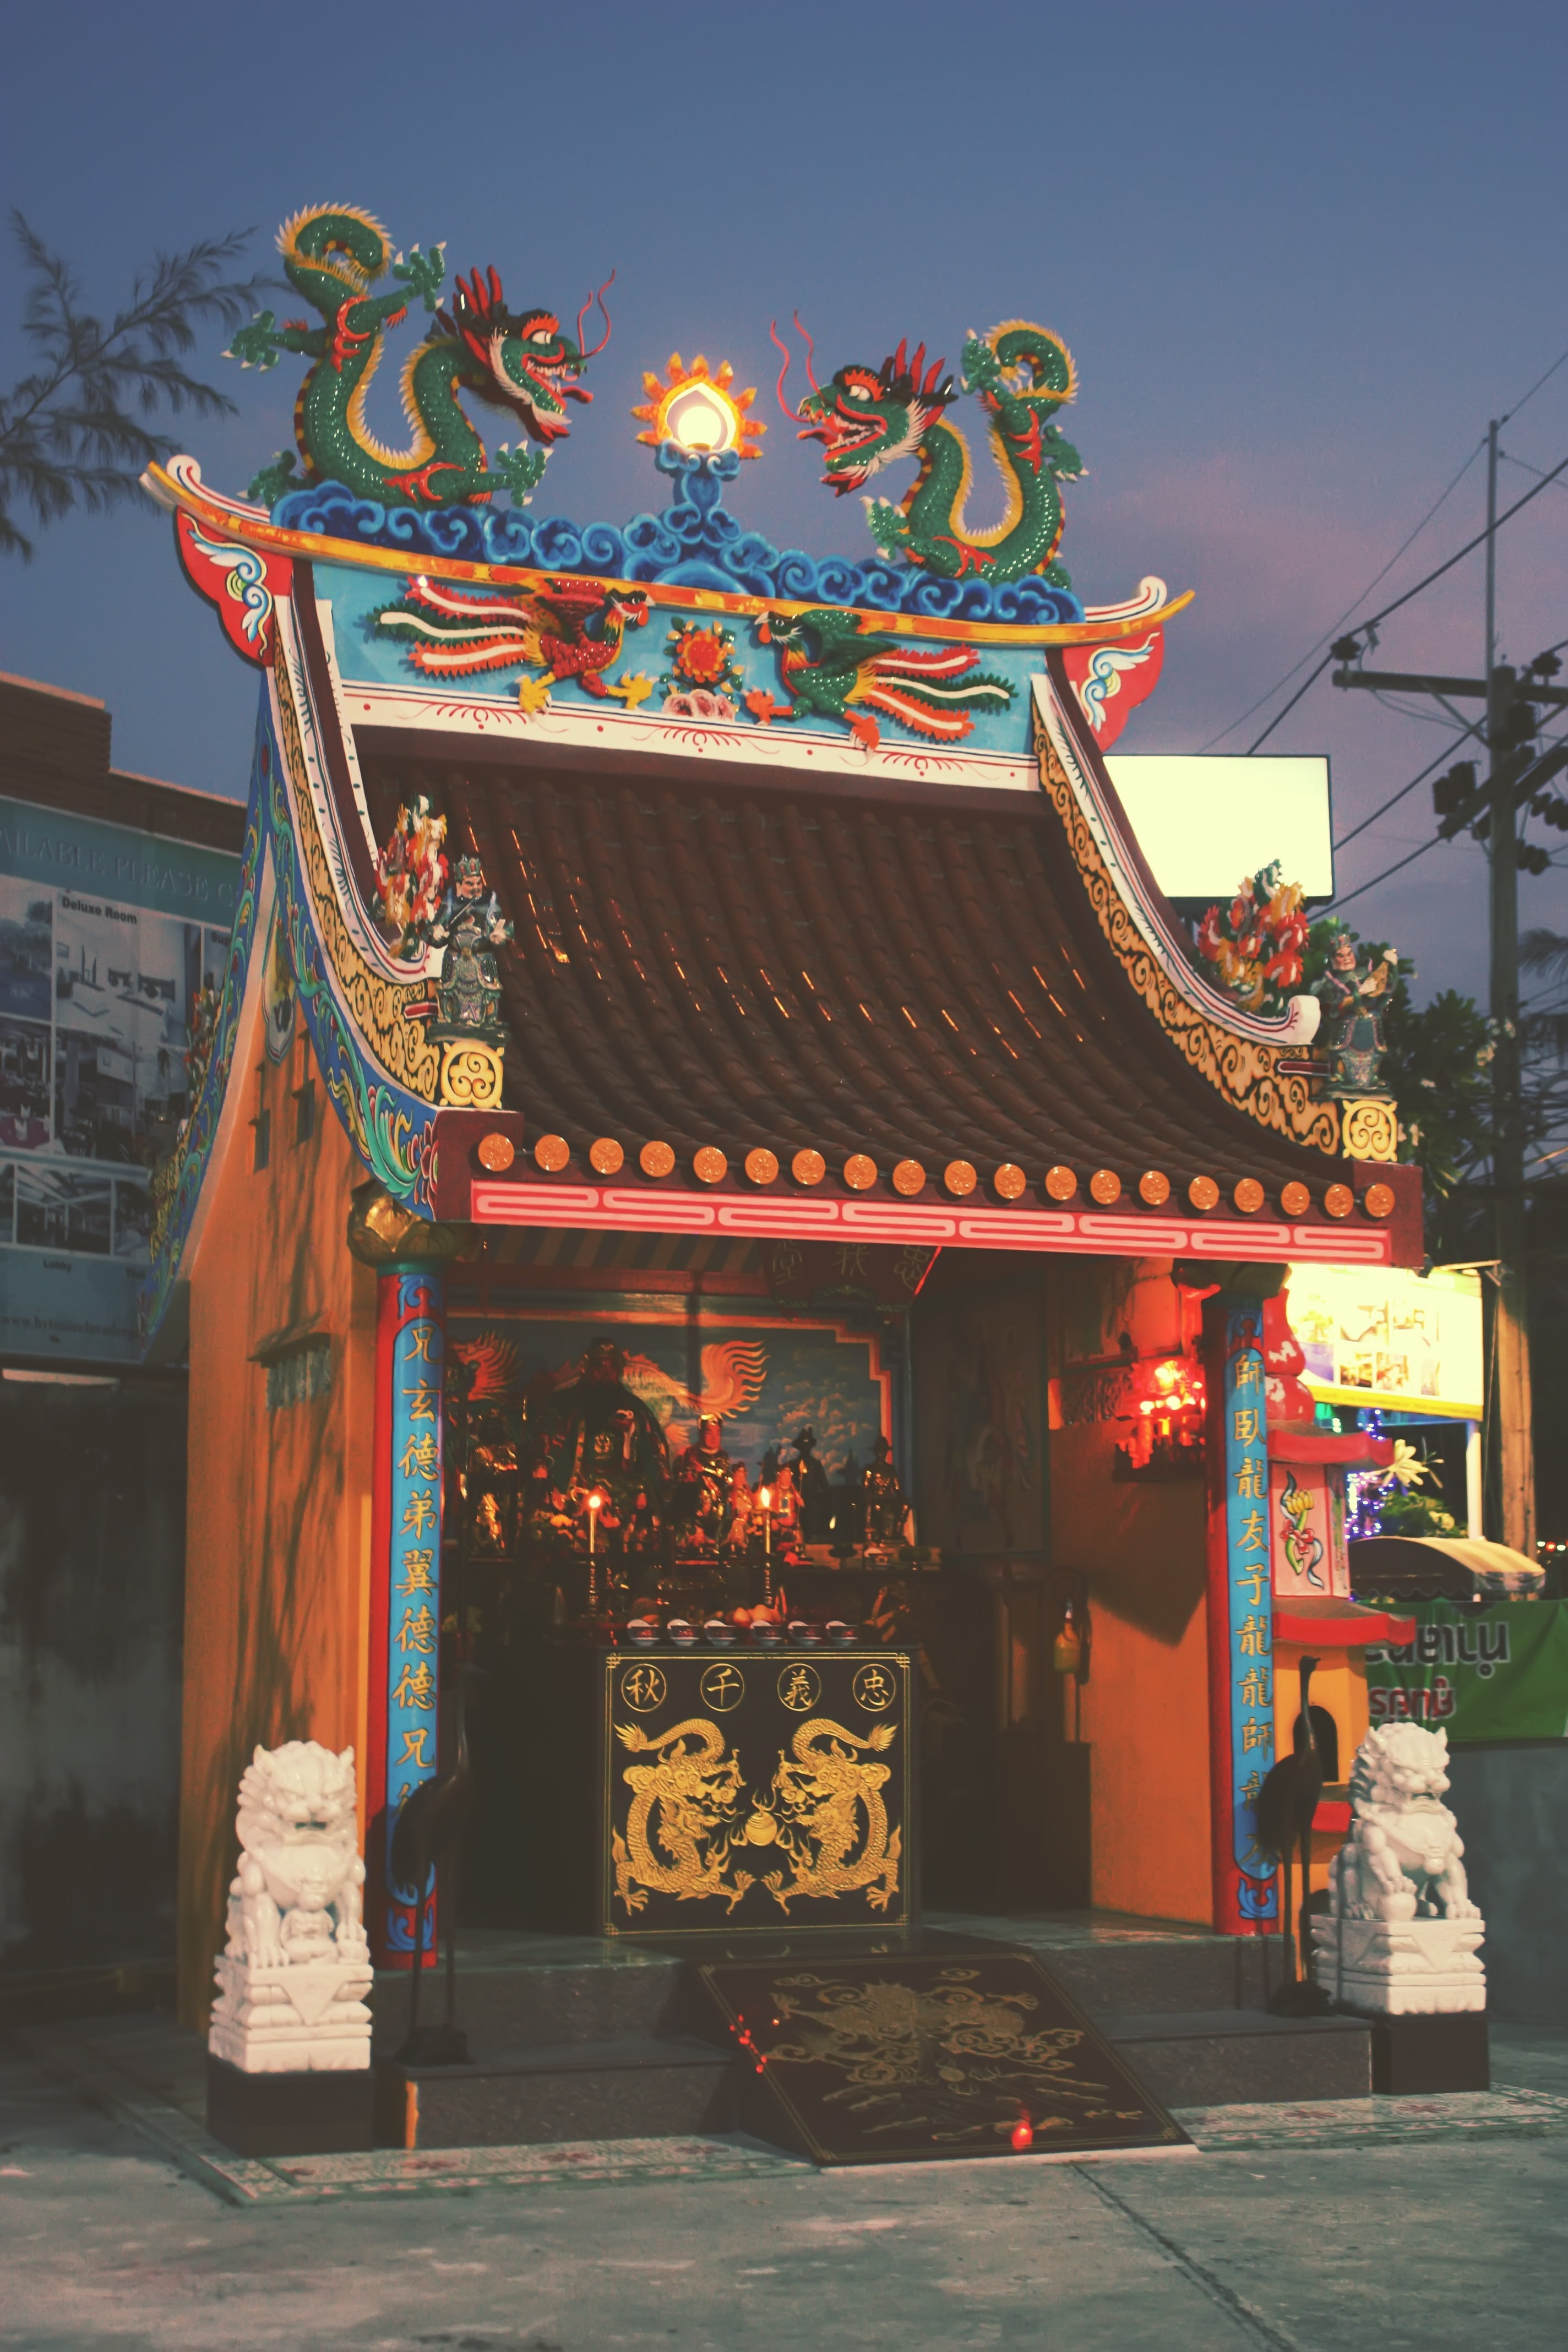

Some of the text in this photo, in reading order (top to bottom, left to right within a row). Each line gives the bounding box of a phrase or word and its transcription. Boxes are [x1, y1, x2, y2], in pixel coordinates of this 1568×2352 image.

[62, 895, 138, 925] Deluxe Room
[43, 1257, 72, 1273] Lobby
[391, 1325, 441, 1817] 兄玄德弟翼德德兄
